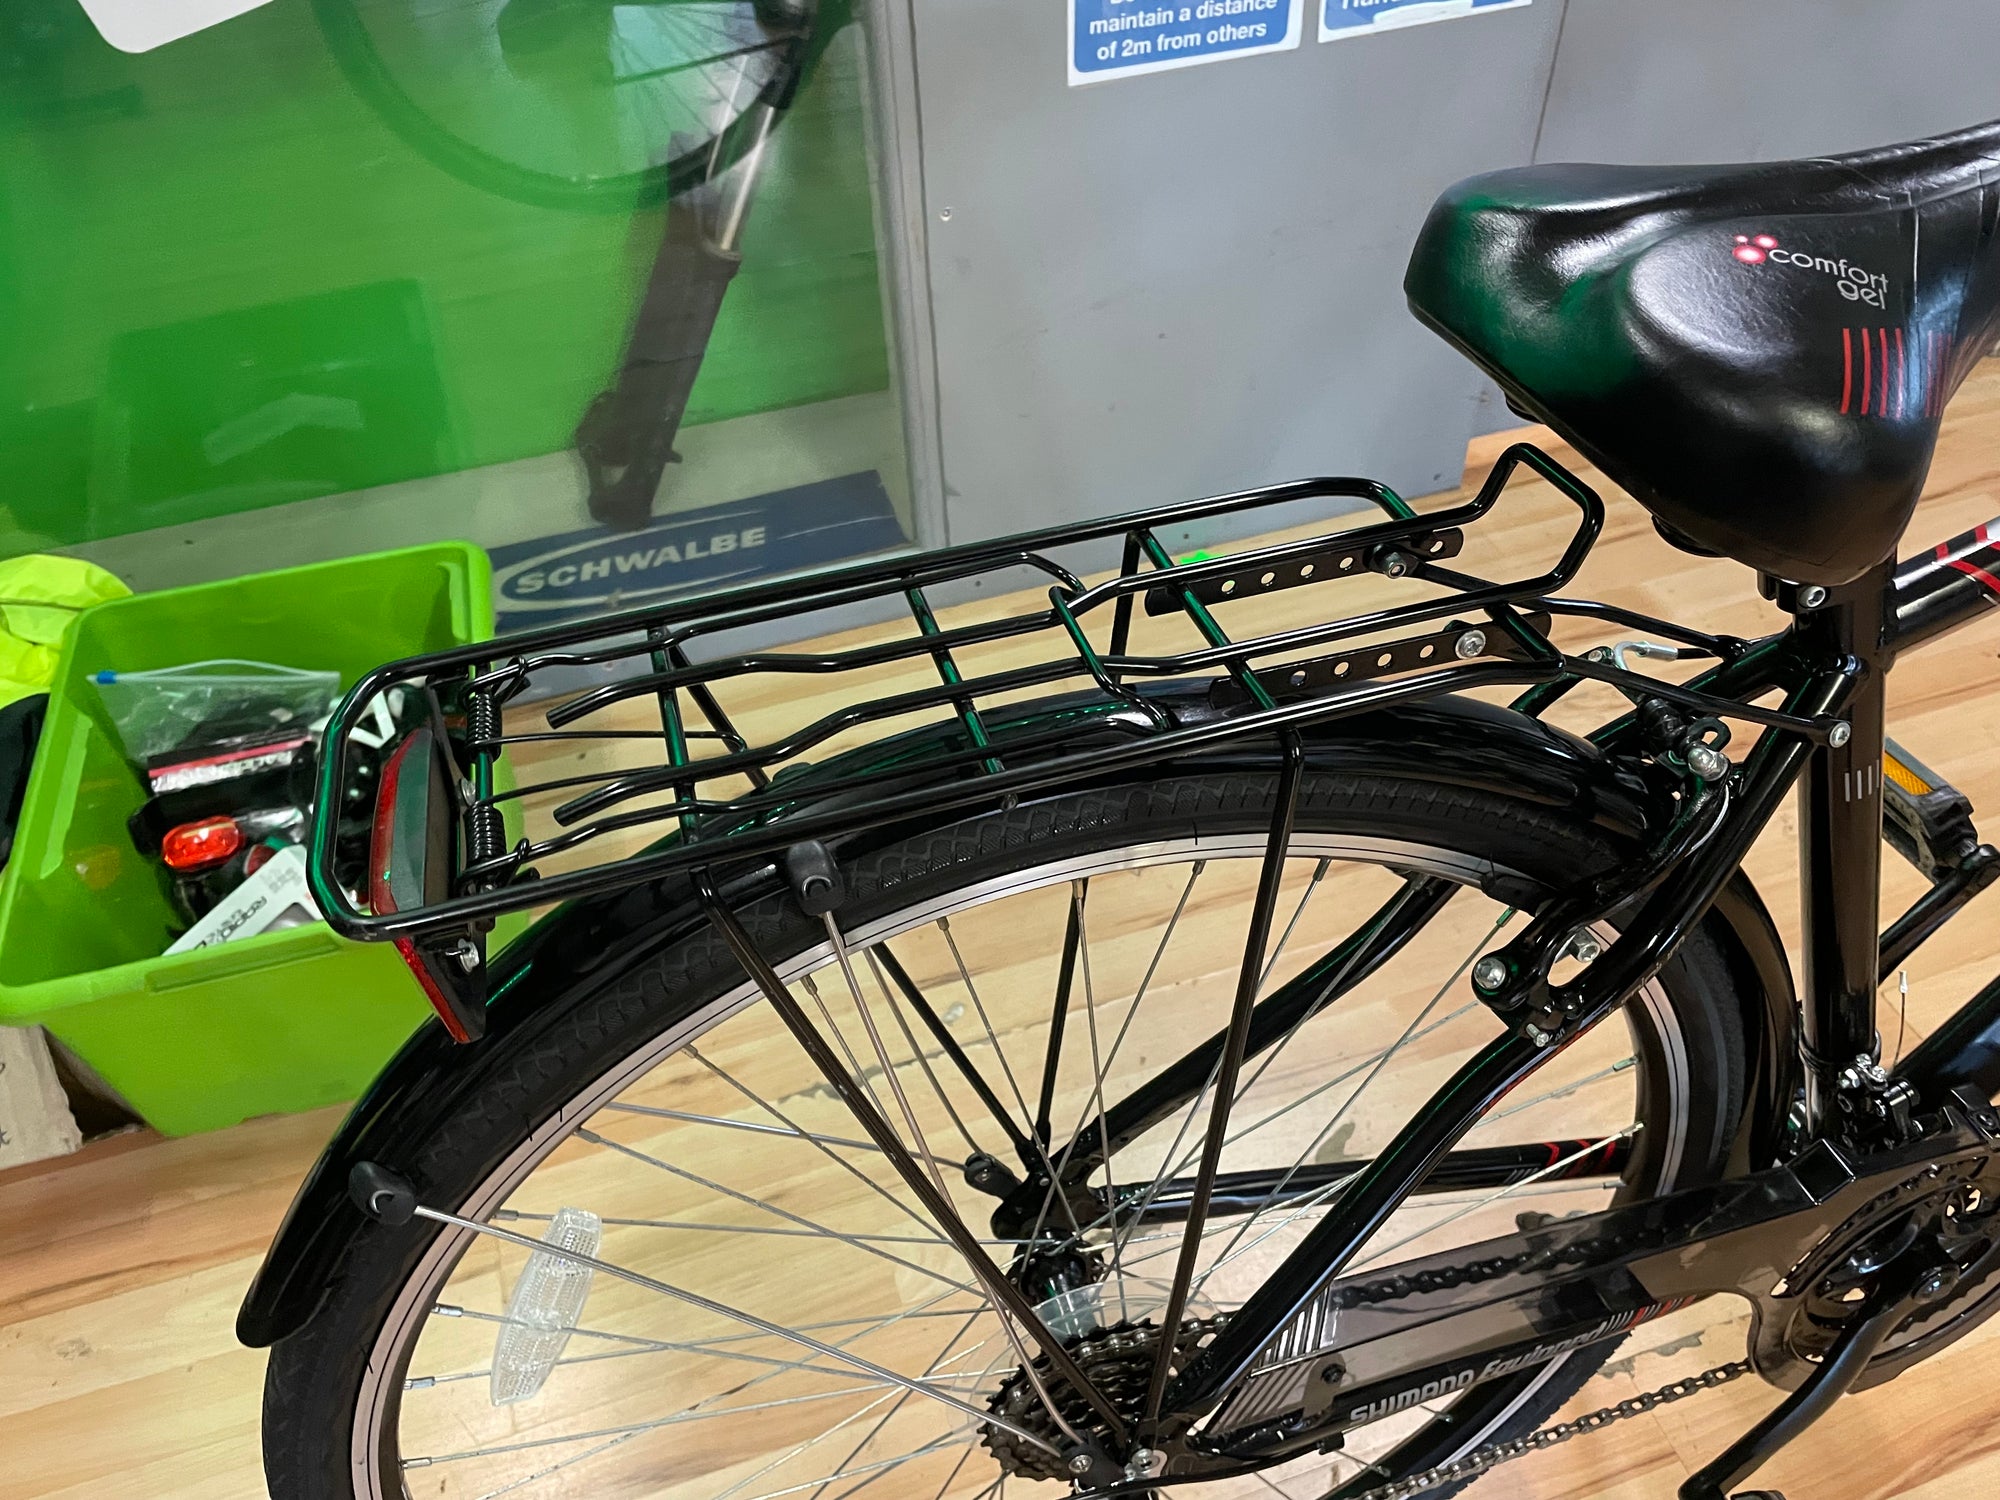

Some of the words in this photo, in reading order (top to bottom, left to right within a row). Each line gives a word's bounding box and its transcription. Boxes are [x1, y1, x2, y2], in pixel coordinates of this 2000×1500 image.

[1089, 7, 1175, 35] maintain
[1179, 7, 1191, 22] a
[1195, 0, 1278, 20] distance
[1096, 40, 1117, 60] of
[1121, 38, 1152, 57] 2m
[1157, 33, 1202, 52] from
[1206, 23, 1267, 44] others
[1768, 248, 1889, 293] comfort
[1836, 279, 1886, 310] gel
[514, 526, 767, 595] SCHWALBE
[1349, 1368, 1475, 1424] SHIMANO
